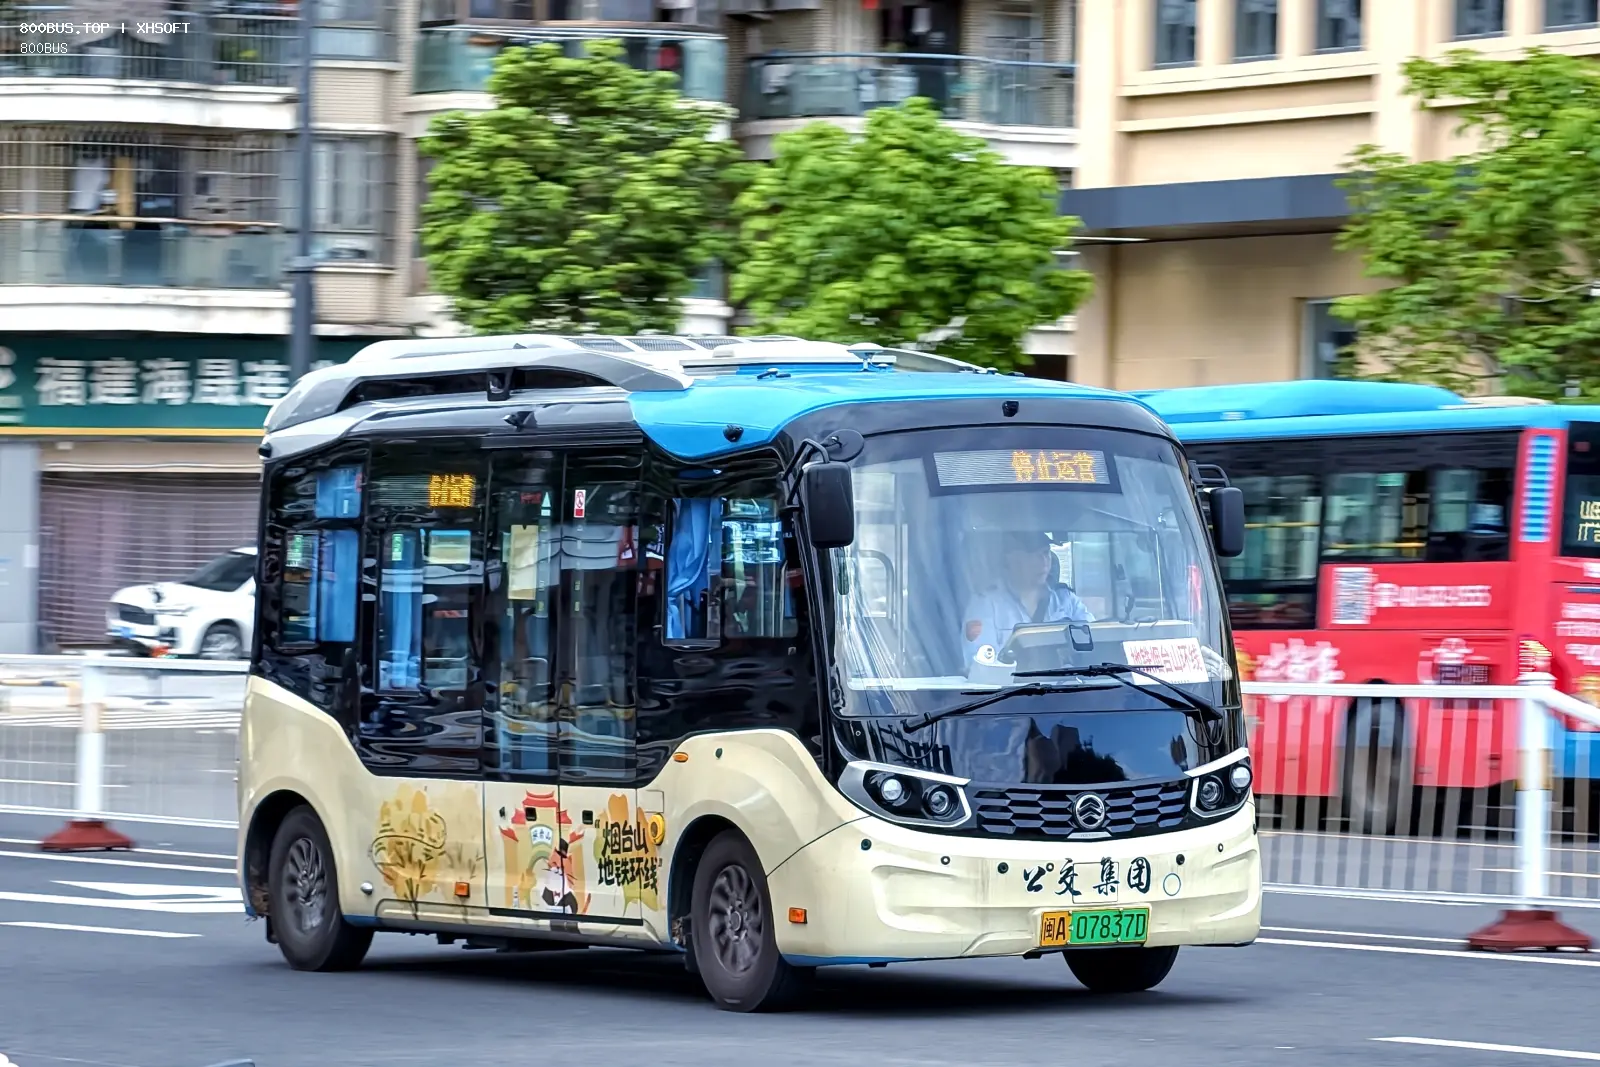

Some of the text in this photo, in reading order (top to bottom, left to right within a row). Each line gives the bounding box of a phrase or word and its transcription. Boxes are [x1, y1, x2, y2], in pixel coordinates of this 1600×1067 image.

[1012, 450, 1096, 482] 停止运营
[1023, 856, 1151, 896] 公交集团
